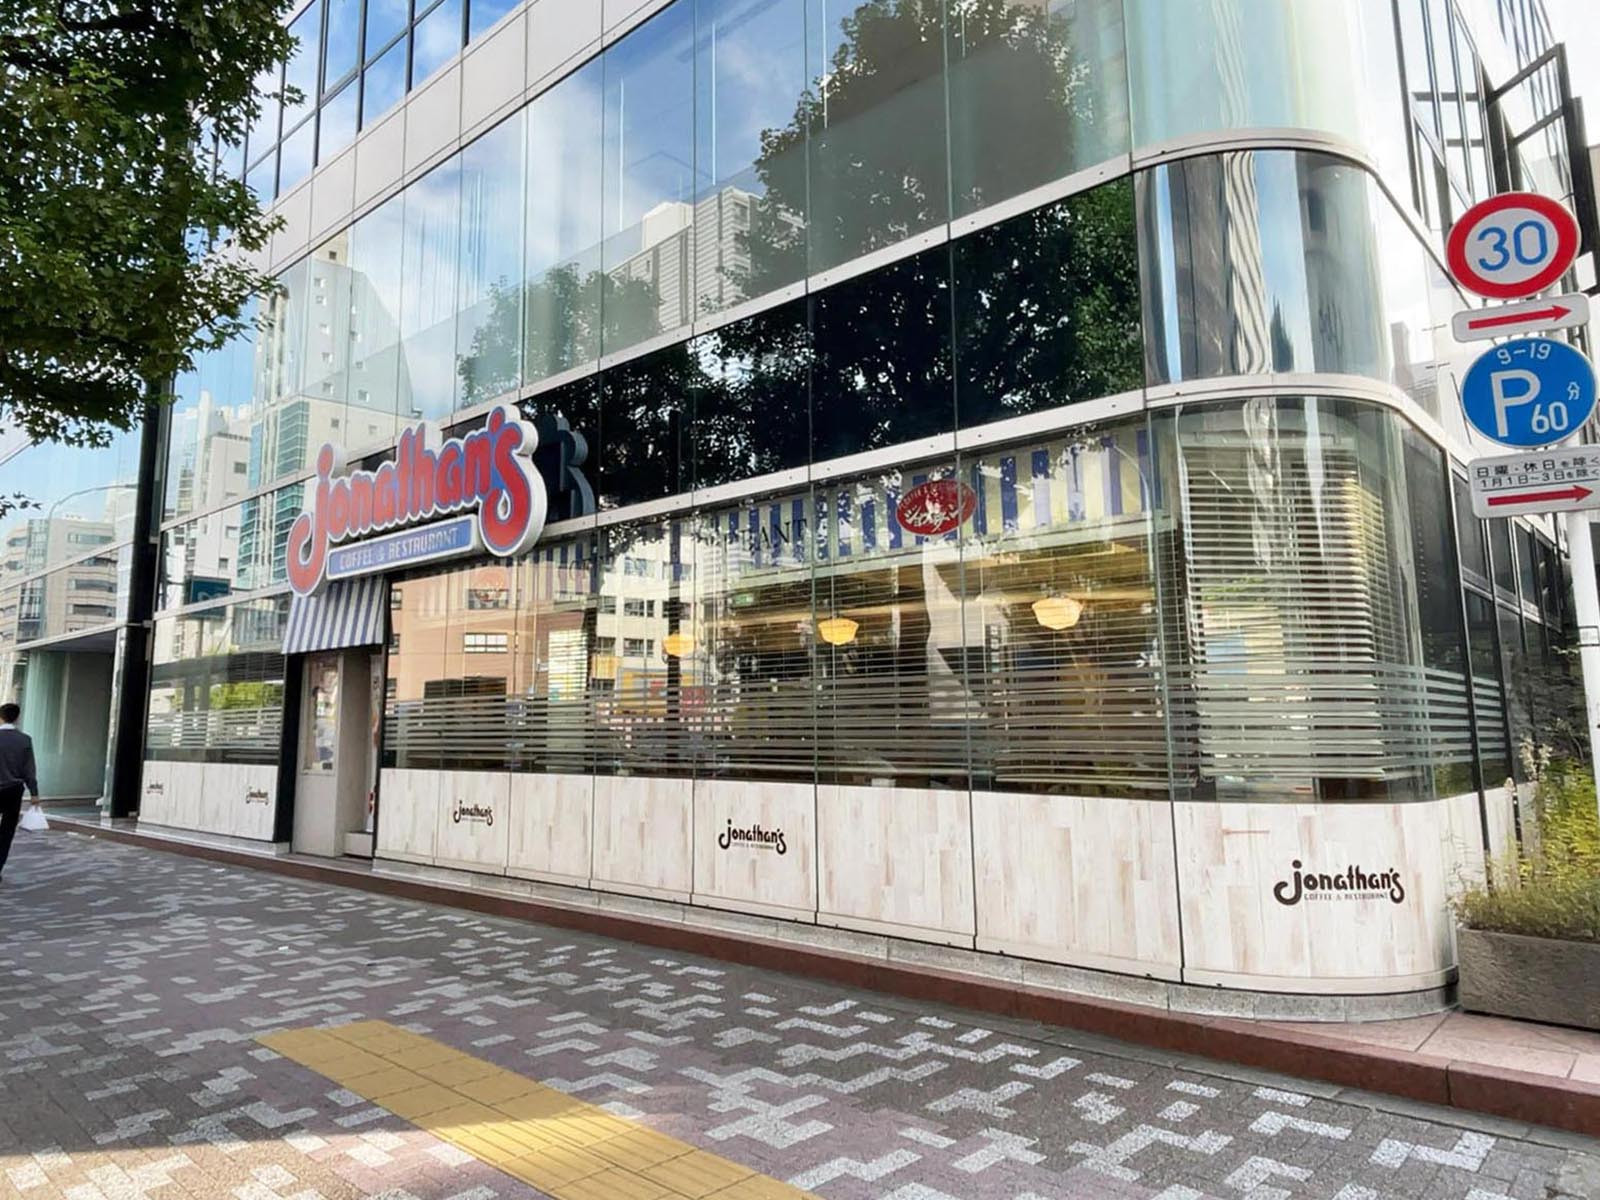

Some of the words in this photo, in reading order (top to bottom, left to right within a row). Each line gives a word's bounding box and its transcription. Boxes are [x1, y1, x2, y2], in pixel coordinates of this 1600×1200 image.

[1477, 220, 1548, 272] 30
[1496, 342, 1551, 365] 9-19
[1491, 369, 1541, 437] P
[1531, 402, 1568, 433] 60
[287, 405, 532, 594] jonathan's
[718, 818, 787, 855] jonathan's
[1273, 859, 1405, 905] jonathan's
